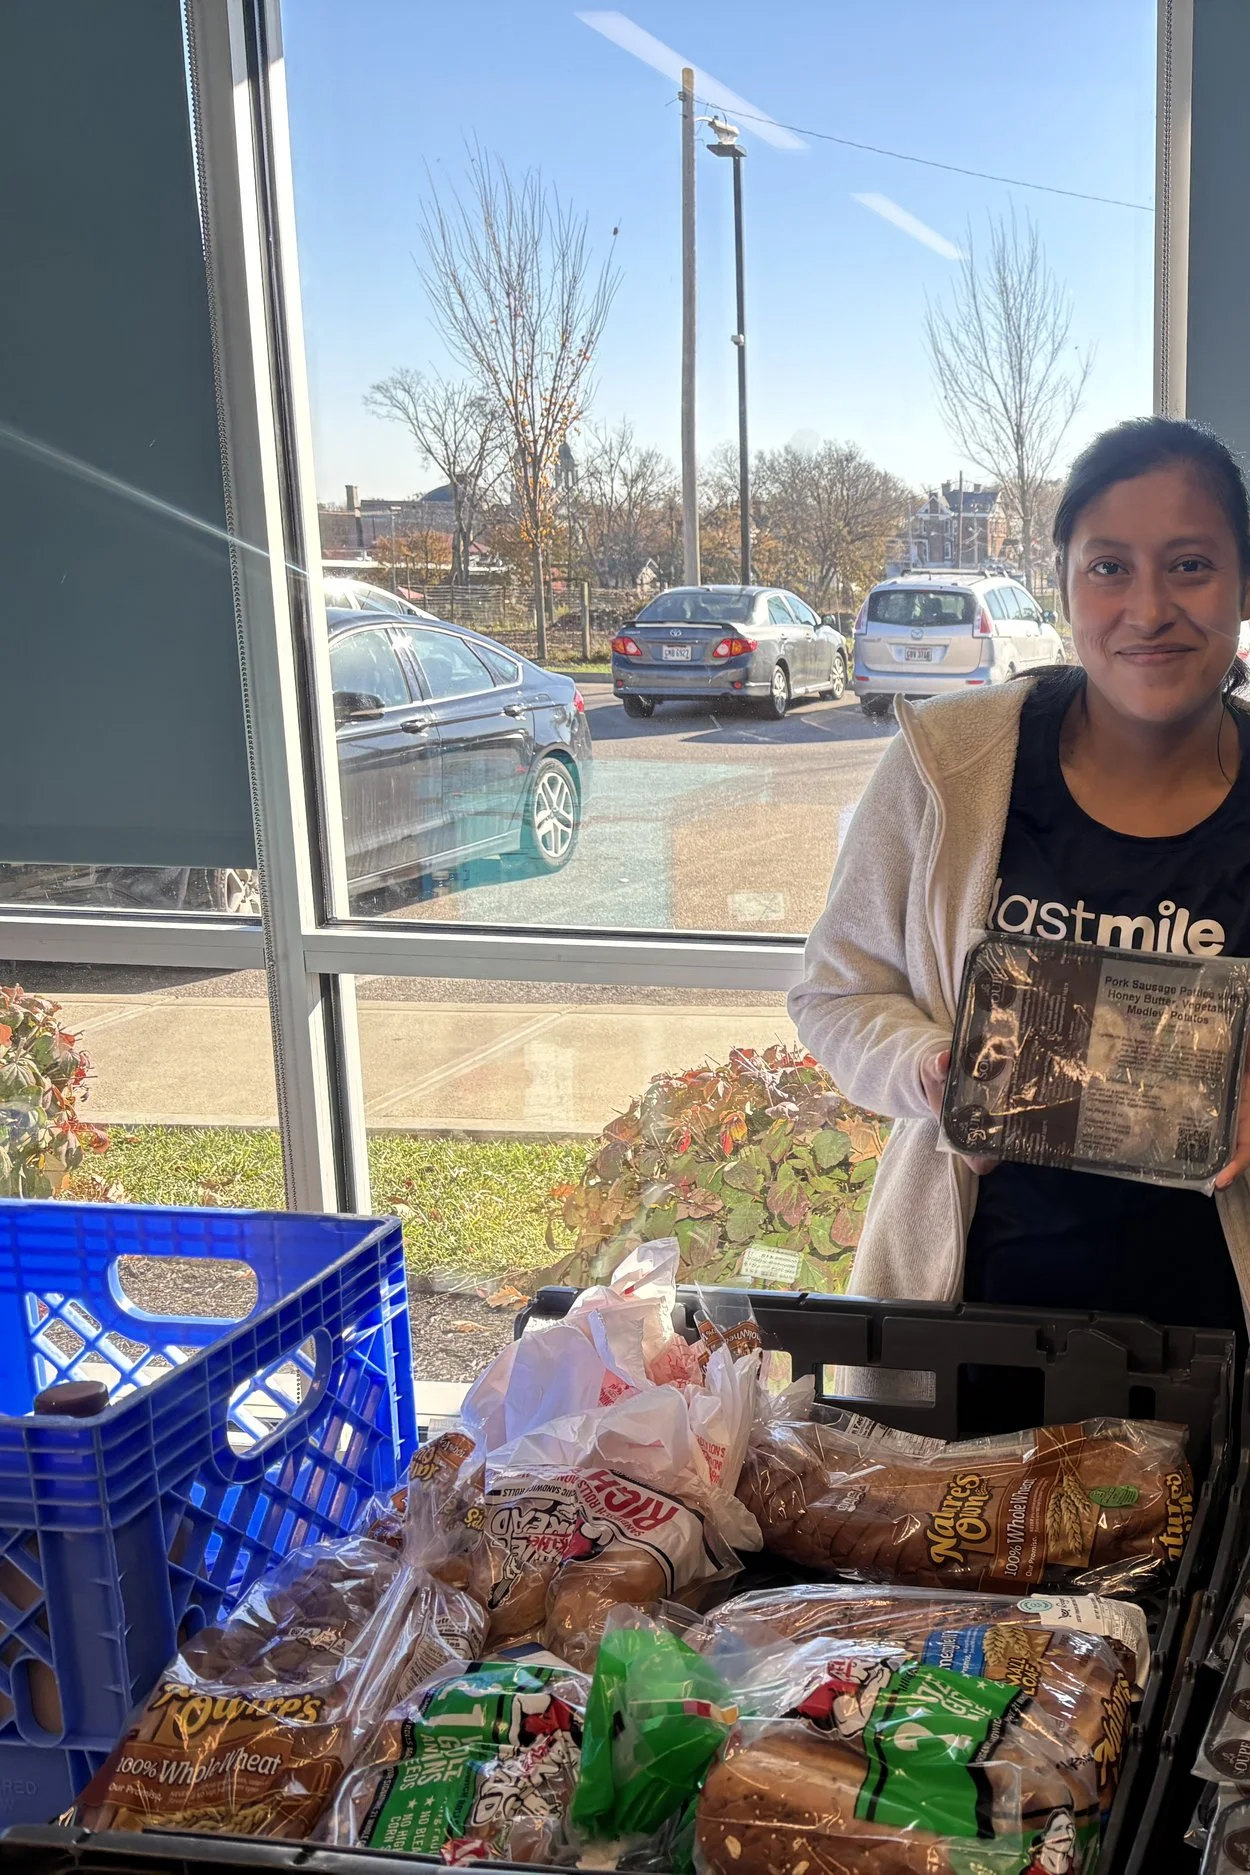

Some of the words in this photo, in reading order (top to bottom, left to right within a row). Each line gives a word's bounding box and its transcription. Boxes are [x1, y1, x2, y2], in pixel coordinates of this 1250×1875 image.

[1105, 975, 1130, 988] Pork
[1132, 979, 1177, 995] Sausage
[1107, 988, 1141, 1004] Honey
[1170, 1008, 1209, 1024] Potatos
[502, 1485, 526, 1498] ROLLS
[577, 1478, 600, 1509] ROLLS
[926, 1474, 980, 1564] Nature's
[955, 1494, 990, 1541] Own
[1004, 1544, 1023, 1577] 100%
[1025, 1565, 1034, 1577] Our
[1023, 1663, 1042, 1697] LOAF
[115, 1756, 157, 1778] 100%
[108, 1781, 125, 1792] Our
[401, 1812, 414, 1828] NO
[420, 1810, 432, 1826] NO
[384, 1815, 402, 1844] CORN
